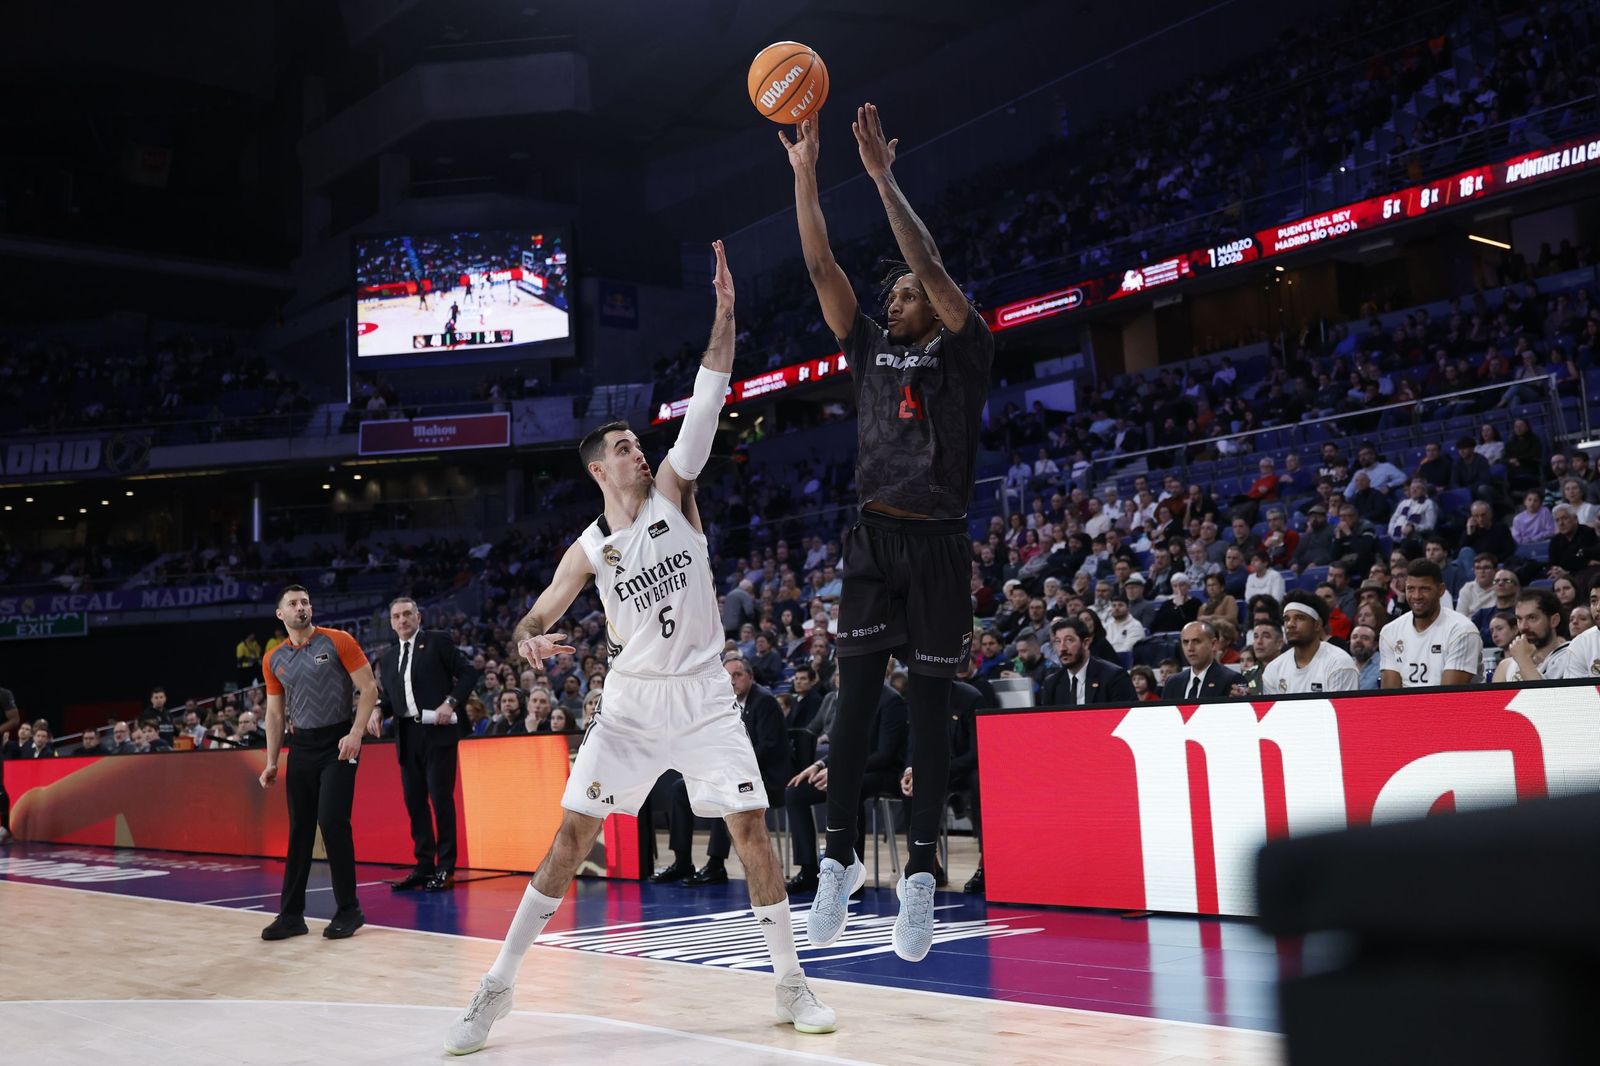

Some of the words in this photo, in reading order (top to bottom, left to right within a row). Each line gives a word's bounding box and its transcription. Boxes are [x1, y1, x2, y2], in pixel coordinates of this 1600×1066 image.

[760, 64, 804, 109] Wilson
[1505, 151, 1561, 184] APÚNTATE
[1561, 149, 1571, 168] A
[1571, 144, 1587, 165] LA
[1274, 233, 1310, 251] MADRID
[1310, 228, 1328, 242] RÍO
[1350, 219, 1358, 230] h
[1277, 221, 1313, 240] PUENTE
[1313, 216, 1332, 231] DEL
[1332, 210, 1351, 224] REY
[1207, 248, 1217, 269] 1
[1217, 237, 1253, 257] MARZO
[1217, 250, 1244, 267] 2026
[413, 424, 457, 437] Mahou
[0, 440, 102, 475] DRID
[614, 550, 693, 602] Emirates
[50, 591, 122, 613] REAL
[140, 578, 240, 609] MADRID
[633, 590, 652, 613] FLY
[652, 571, 688, 603] BETTER
[16, 621, 55, 637] EXIT
[658, 604, 676, 639] 6
[852, 624, 880, 638] asisa
[1408, 662, 1429, 684] 22
